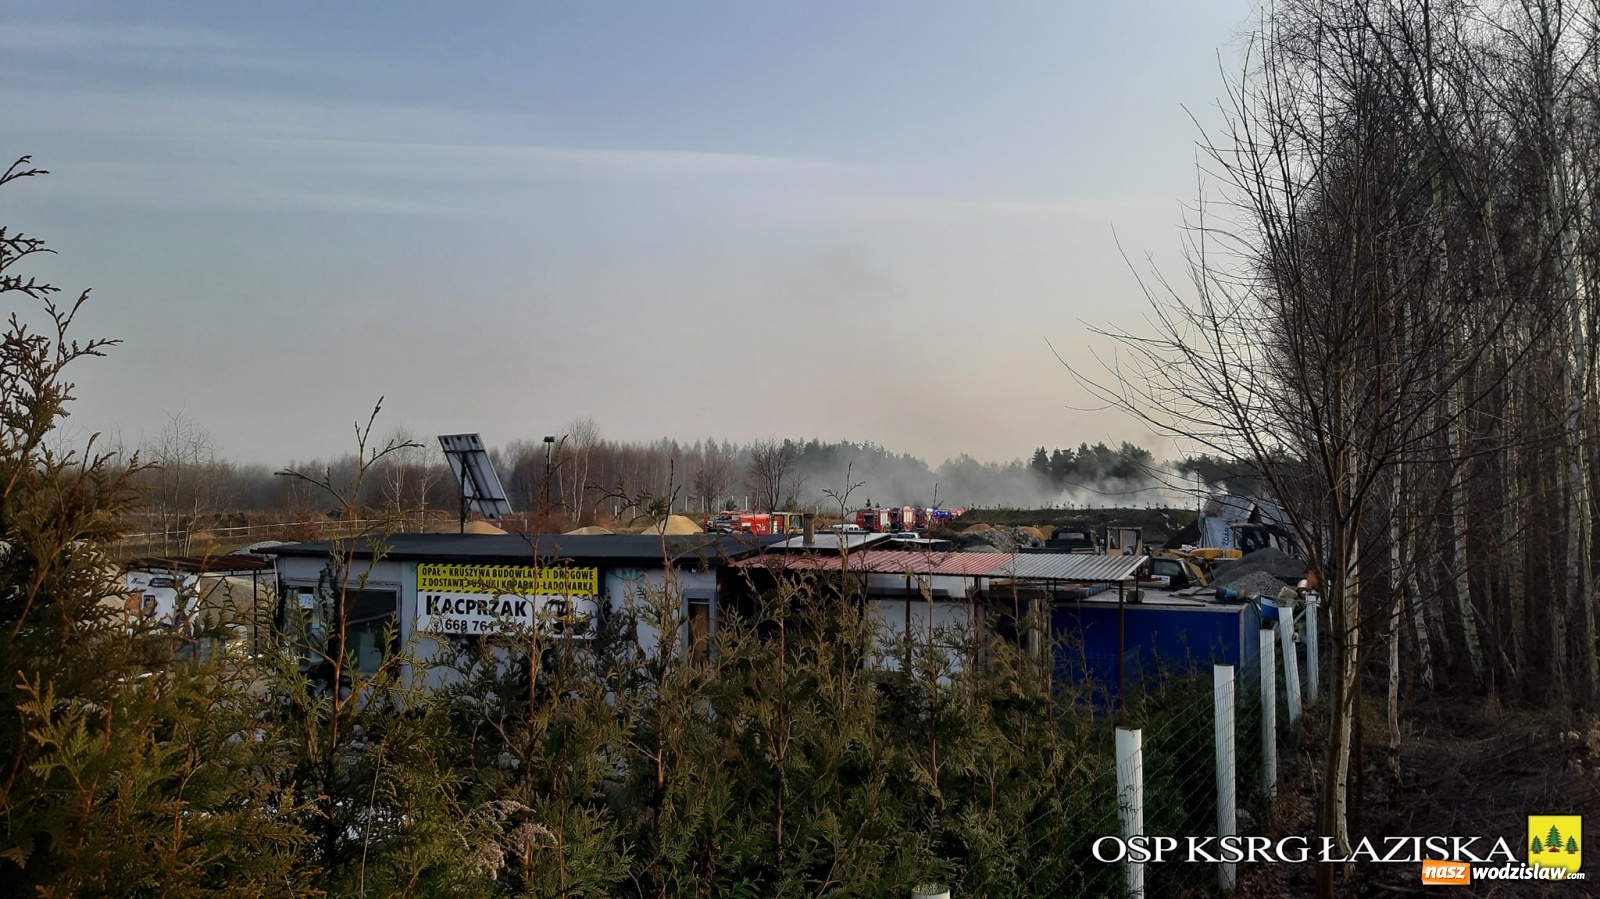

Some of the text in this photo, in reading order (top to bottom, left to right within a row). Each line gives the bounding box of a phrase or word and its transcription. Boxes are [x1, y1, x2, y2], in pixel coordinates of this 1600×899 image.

[422, 567, 441, 576] OPAŁ
[449, 568, 490, 577] KRUSZYWA
[422, 578, 427, 586] Z
[445, 619, 467, 631] 668
